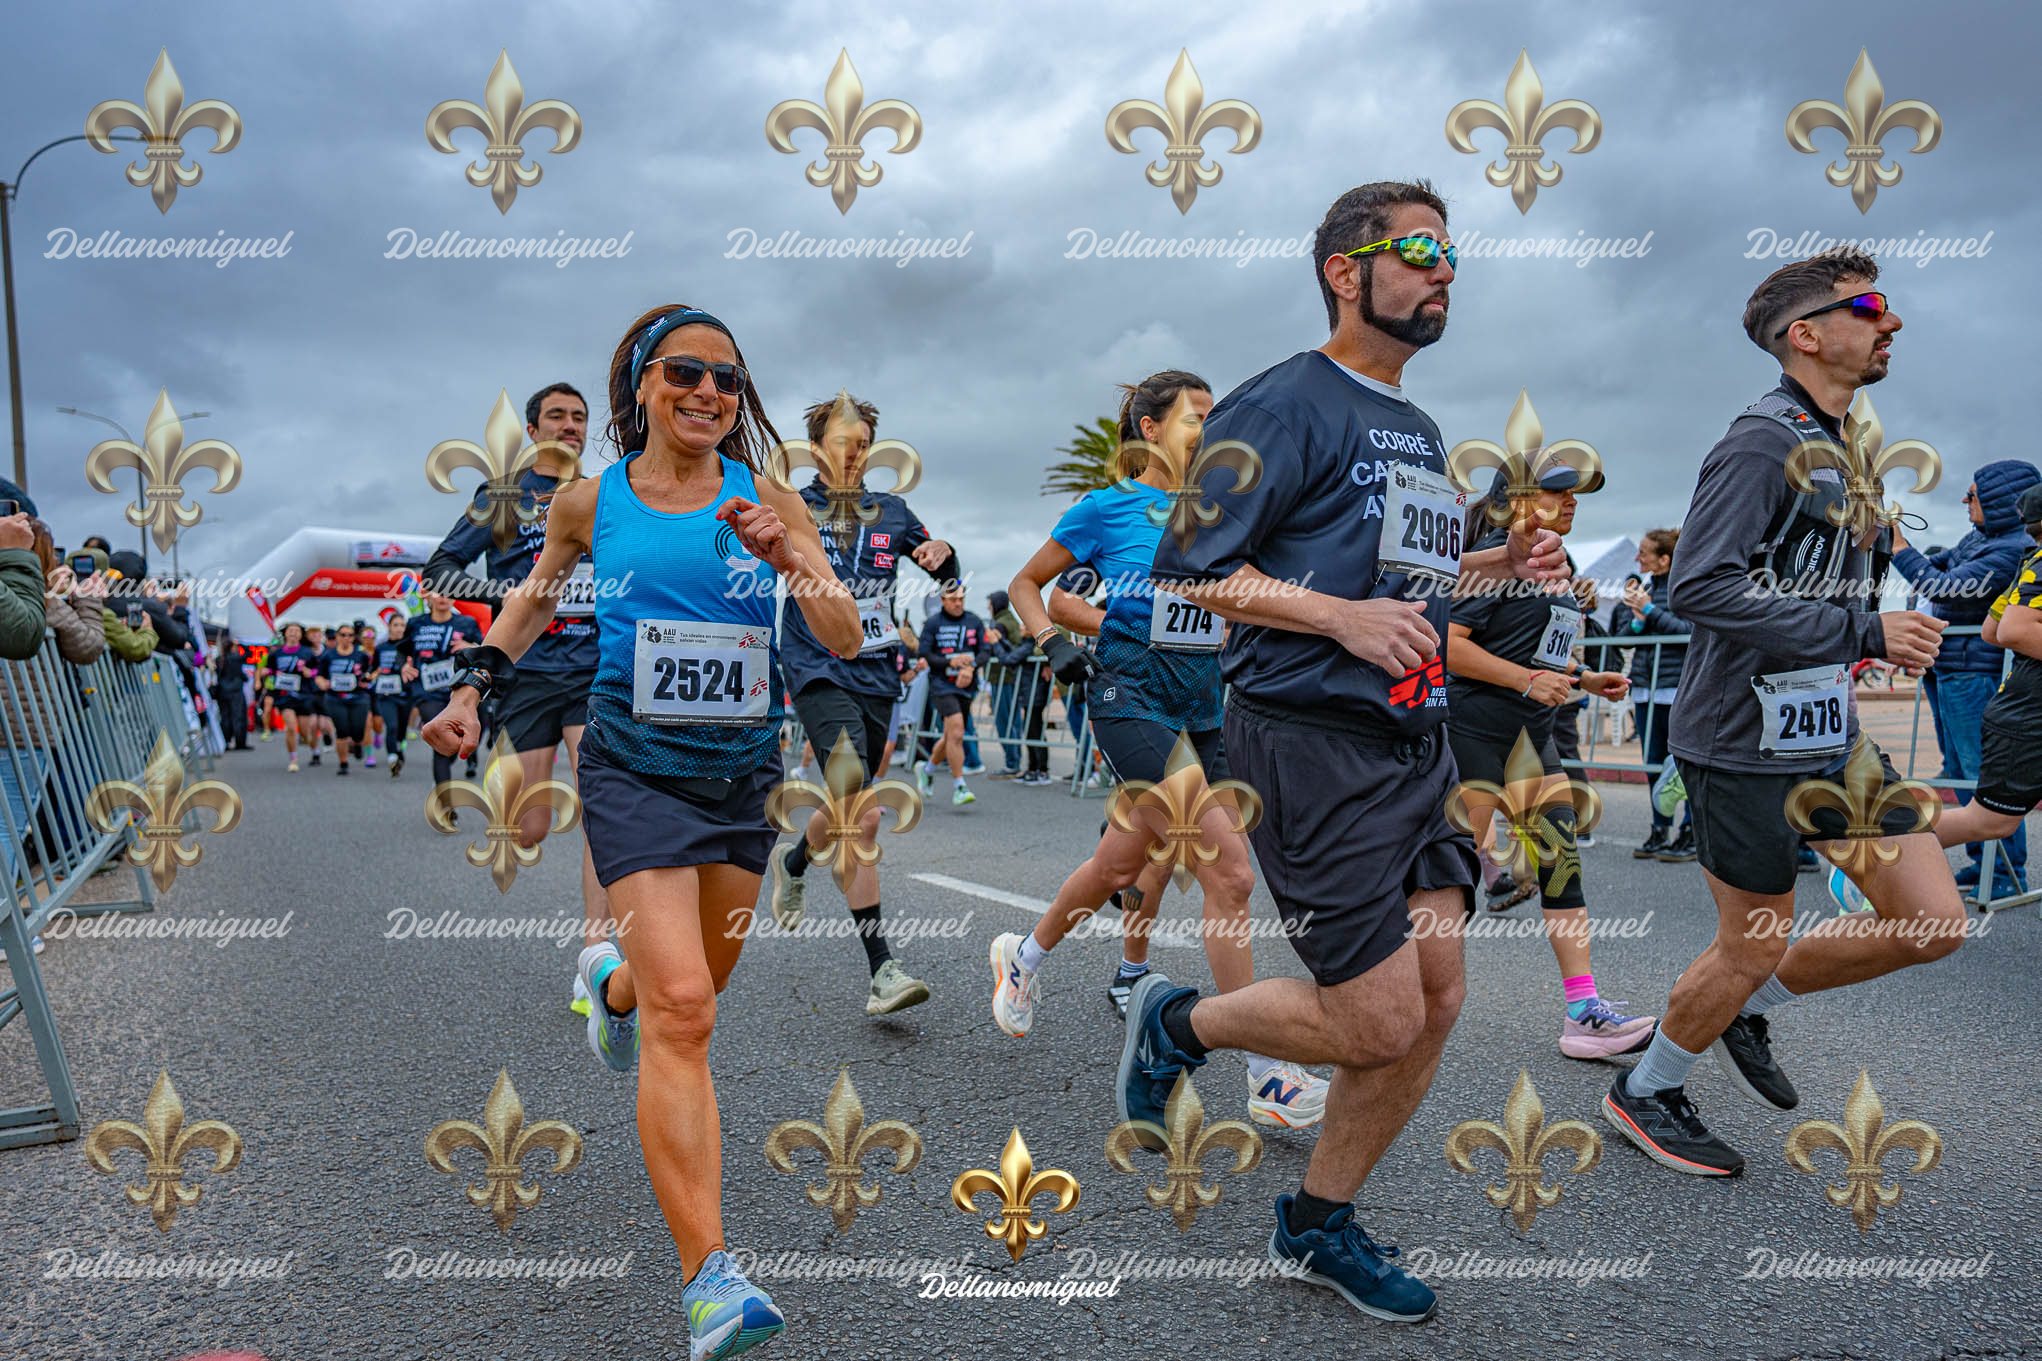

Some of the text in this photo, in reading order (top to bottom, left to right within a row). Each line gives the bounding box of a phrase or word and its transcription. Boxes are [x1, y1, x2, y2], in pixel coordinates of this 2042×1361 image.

[1369, 429, 1433, 456] CORRÉ
[1401, 503, 1460, 562] 2986
[1165, 602, 1212, 634] 2774
[653, 657, 744, 702] 2524
[1424, 698, 1438, 707] SIN
[1779, 697, 1842, 740] 2478
